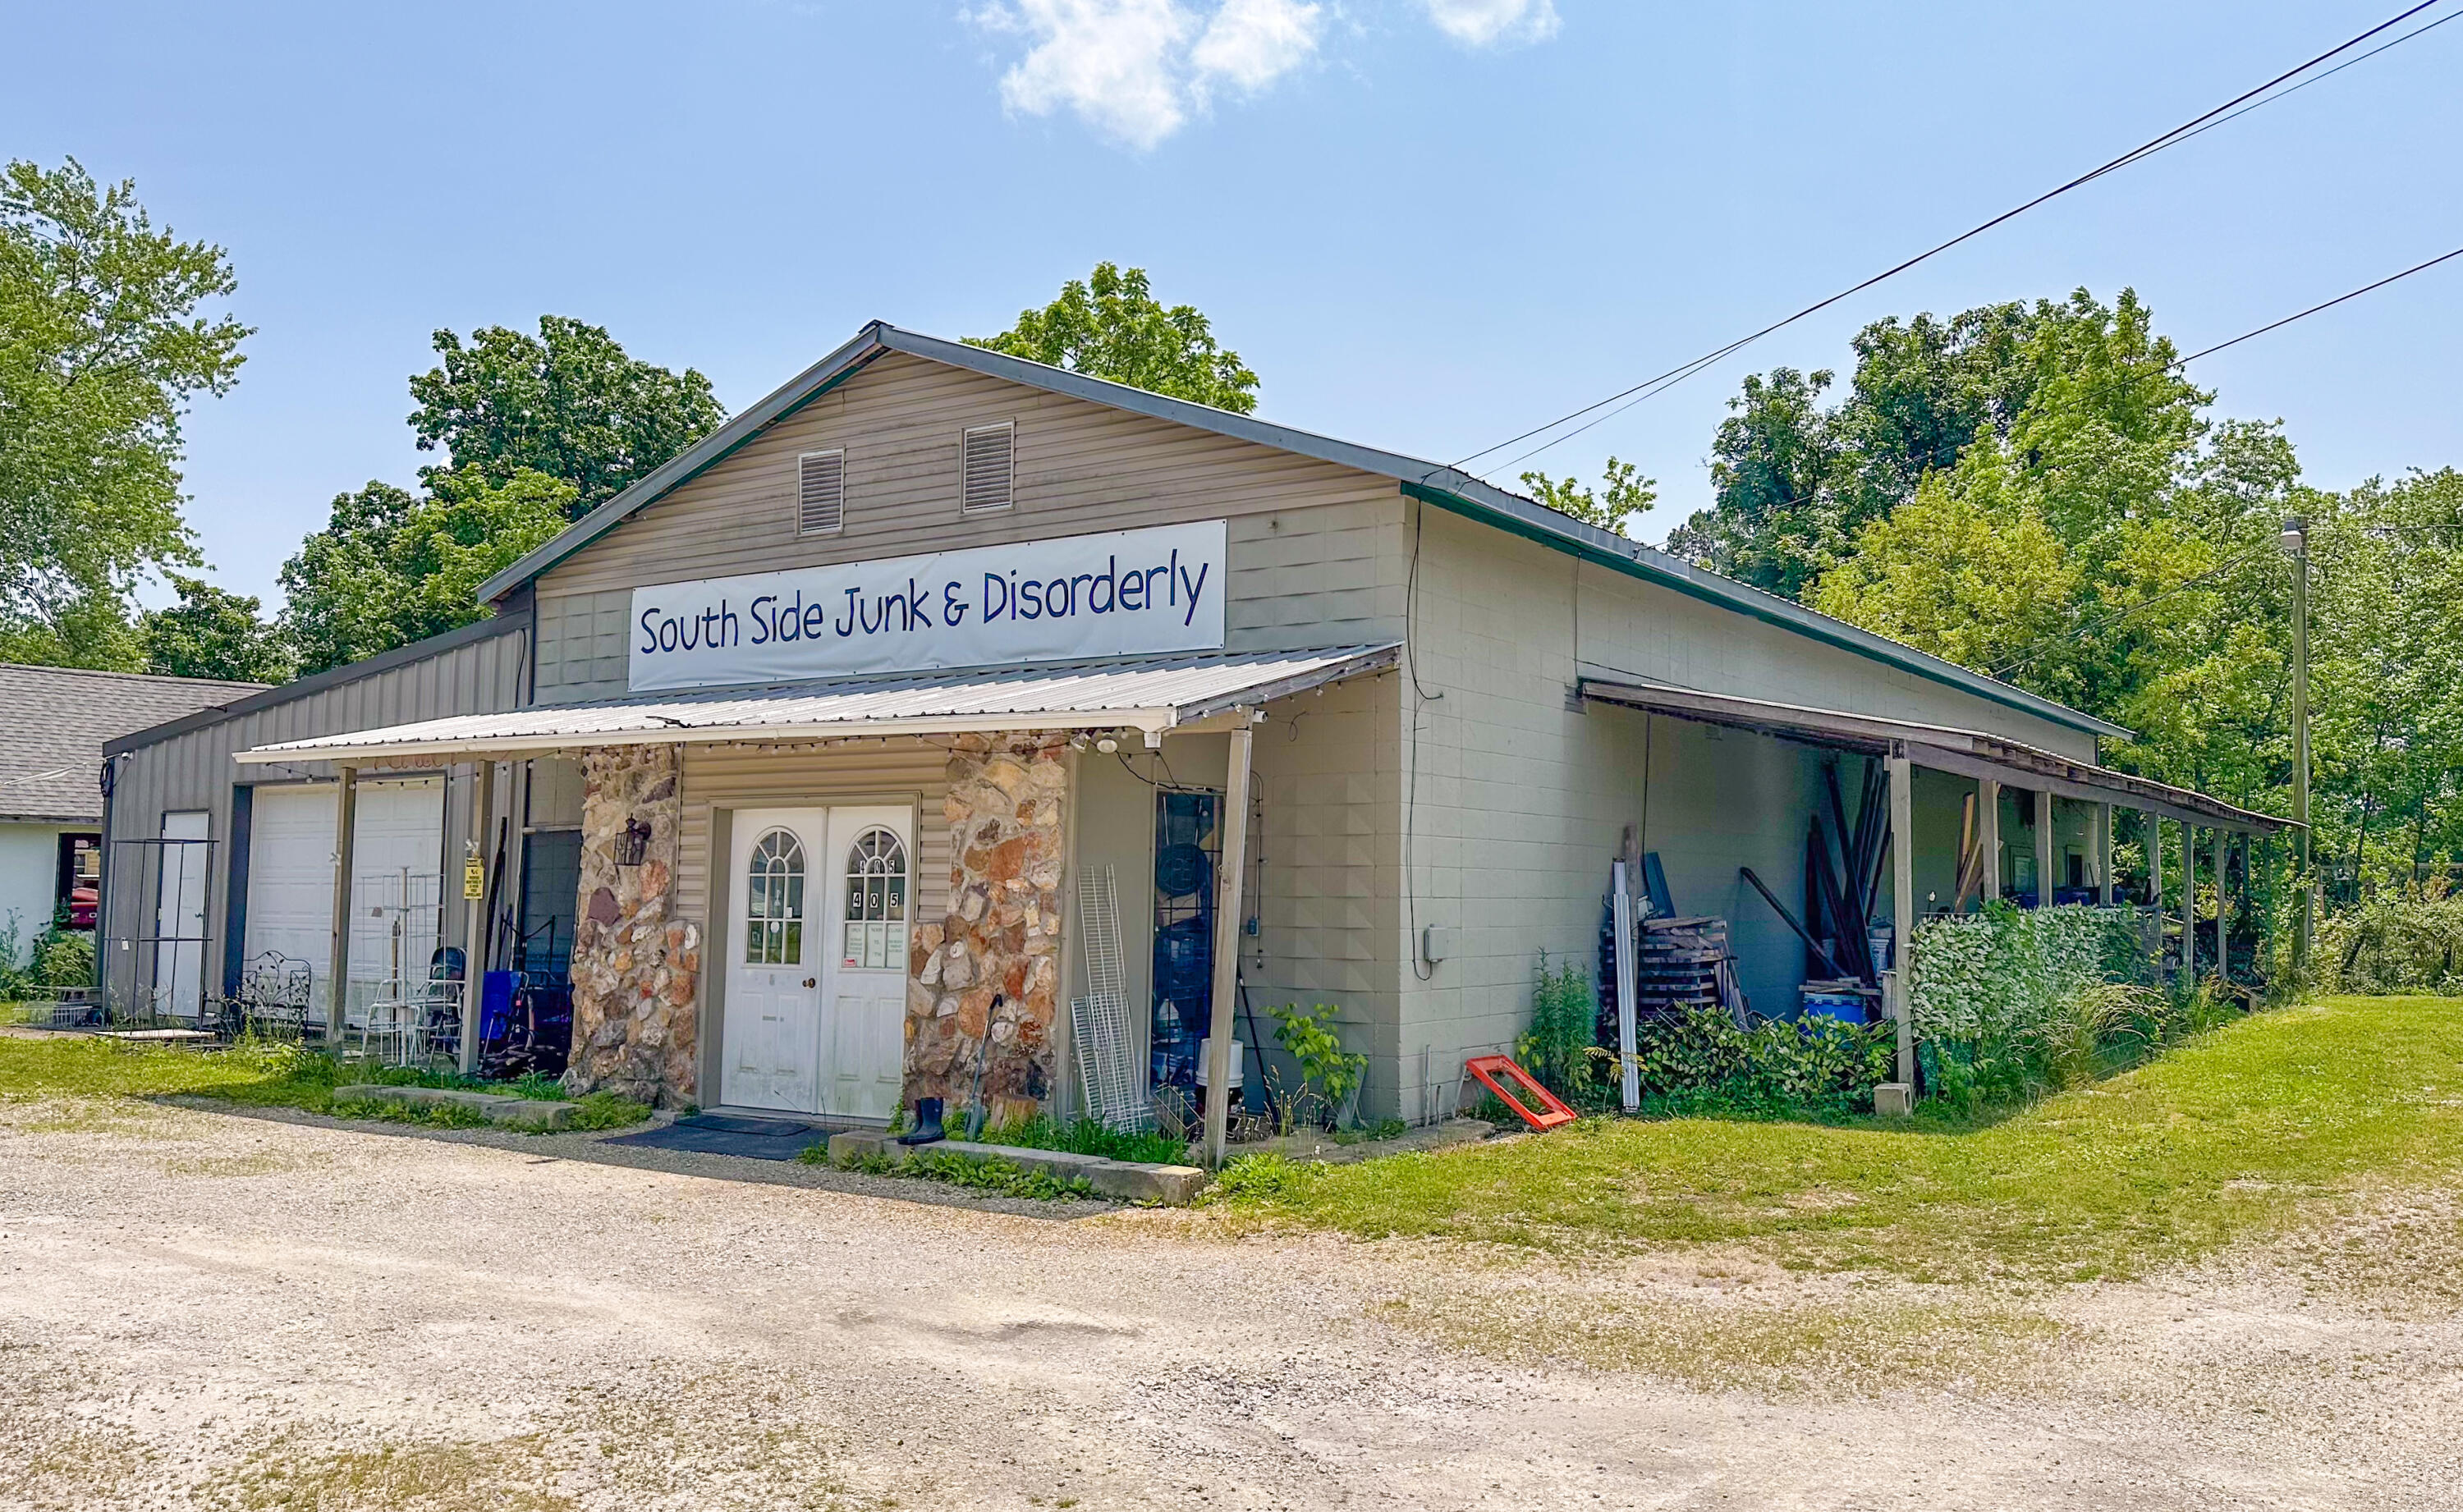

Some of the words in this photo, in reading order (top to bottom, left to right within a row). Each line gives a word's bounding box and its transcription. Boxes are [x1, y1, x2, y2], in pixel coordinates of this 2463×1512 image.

[640, 598, 739, 654] South
[750, 589, 823, 645] Side
[835, 577, 933, 639] Junk
[943, 581, 970, 627] &
[983, 548, 1209, 628] Disorderly
[854, 893, 898, 906] 405
